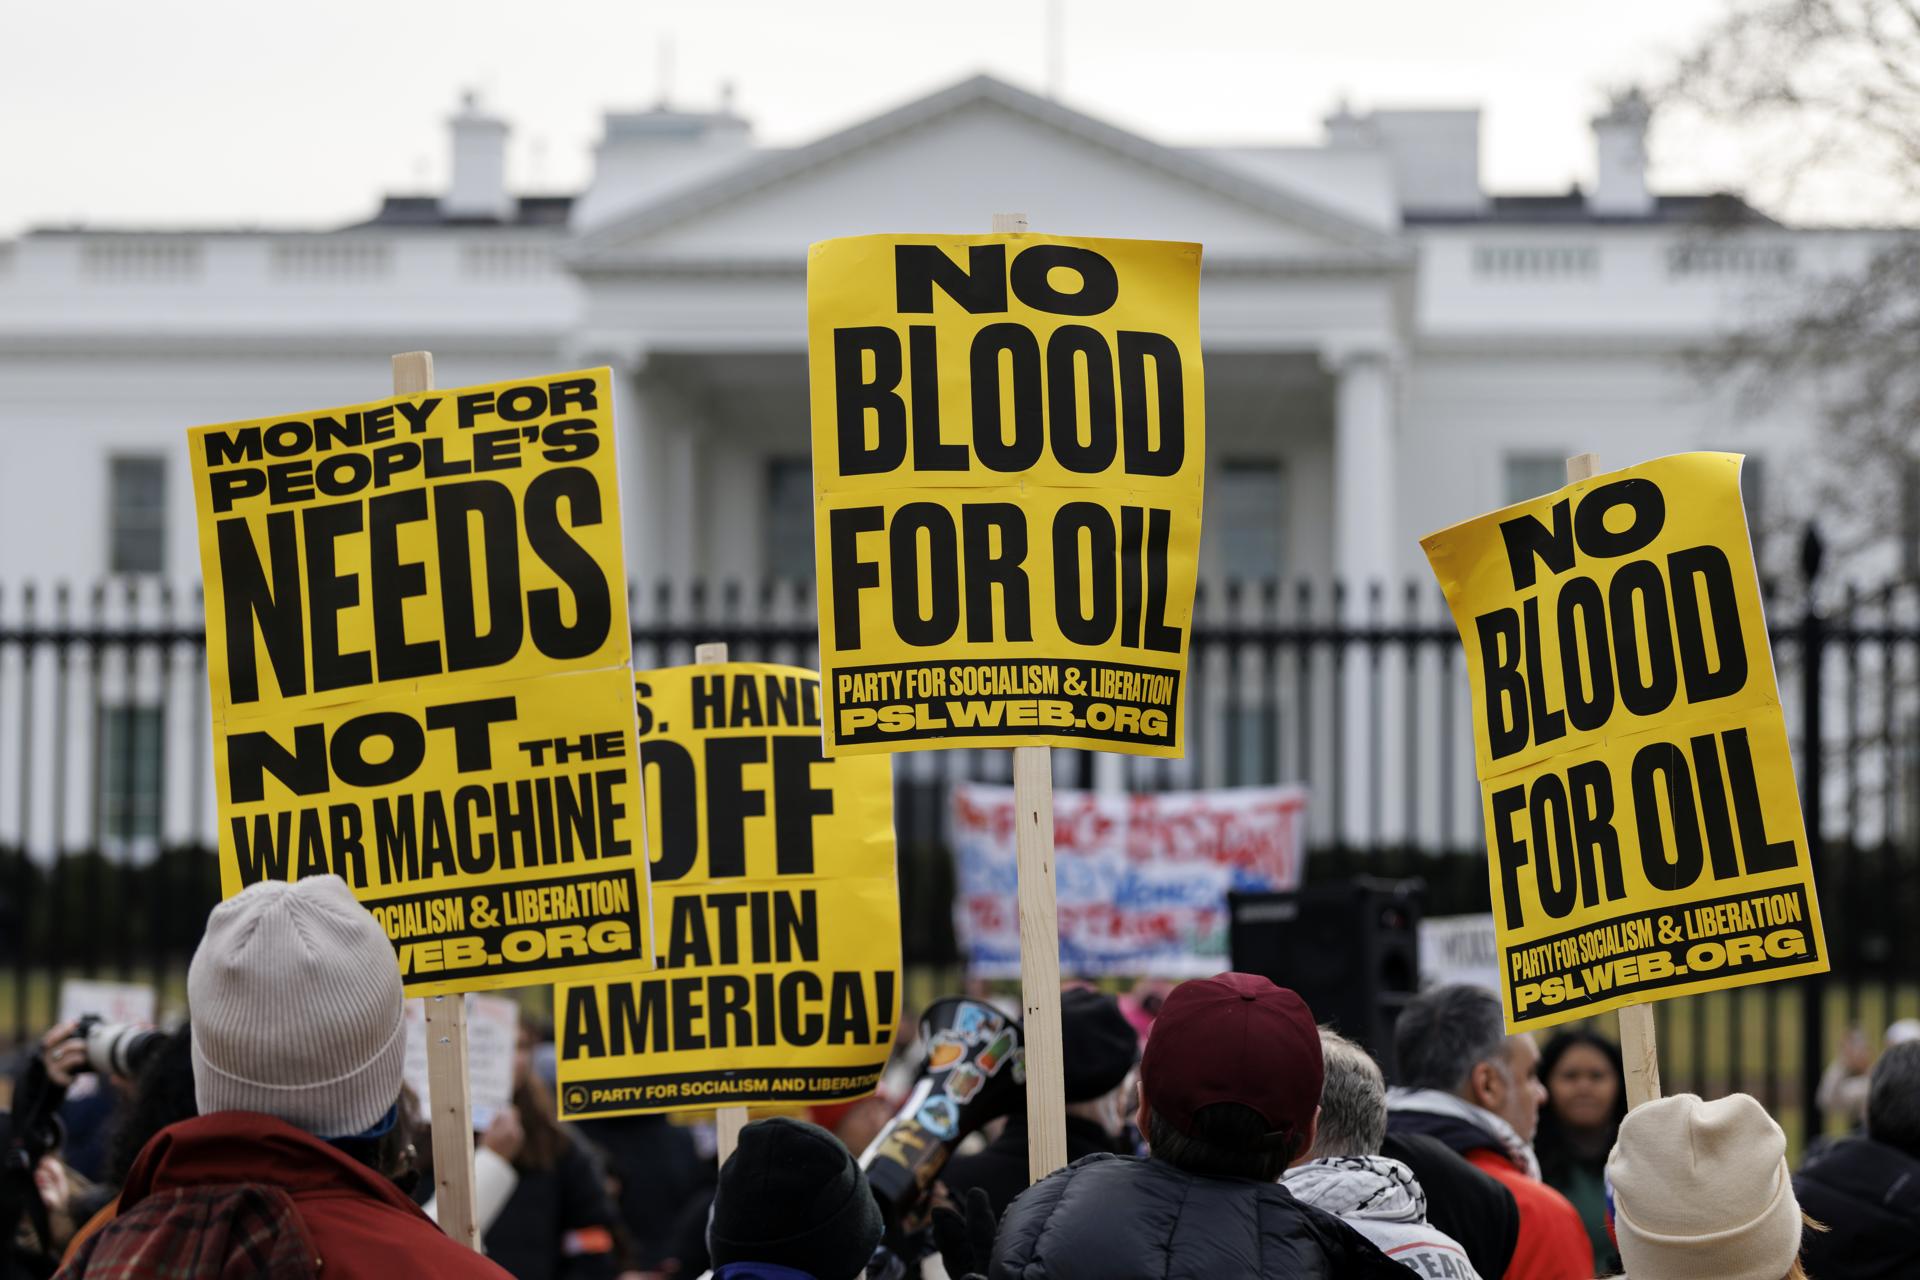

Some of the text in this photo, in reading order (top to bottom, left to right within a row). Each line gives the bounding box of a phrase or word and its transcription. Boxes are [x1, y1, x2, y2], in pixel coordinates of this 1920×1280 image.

[894, 243, 1119, 316] NO
[204, 378, 597, 467] MONEY FOR
[834, 322, 1185, 477] BLOOD
[209, 418, 600, 513] PEOPLE'S
[830, 501, 1183, 654] FOR OIL
[1499, 478, 1665, 592] NO
[217, 466, 612, 704] NEEDS
[838, 665, 1174, 706] PARTY FOR SOCIALISM & LIBERATION
[1475, 544, 1749, 761] BLOOD
[692, 674, 821, 729] HAND
[840, 699, 1168, 737] PSLWEB.ORG
[226, 696, 626, 804] NOT THE
[231, 769, 632, 889] WAR MACHINE
[640, 736, 835, 881] OFF
[1491, 727, 1799, 931] FOR OIL
[372, 878, 630, 940] OCIALISM & LIBERATION
[657, 890, 819, 969] ATIN
[1512, 943, 1553, 981] PARTY
[1553, 936, 1580, 971] FOR
[1579, 918, 1655, 964] SOCIALISM
[1657, 915, 1685, 945] &
[1684, 892, 1802, 940] LIBERATION
[562, 970, 895, 1061] AMERICA!
[1514, 929, 1807, 1012] PSLWEB.ORG
[591, 1086, 643, 1104] PARTY
[645, 1084, 678, 1100] FOR
[681, 1079, 769, 1096] SOCIALISM
[771, 1078, 806, 1092] AND
